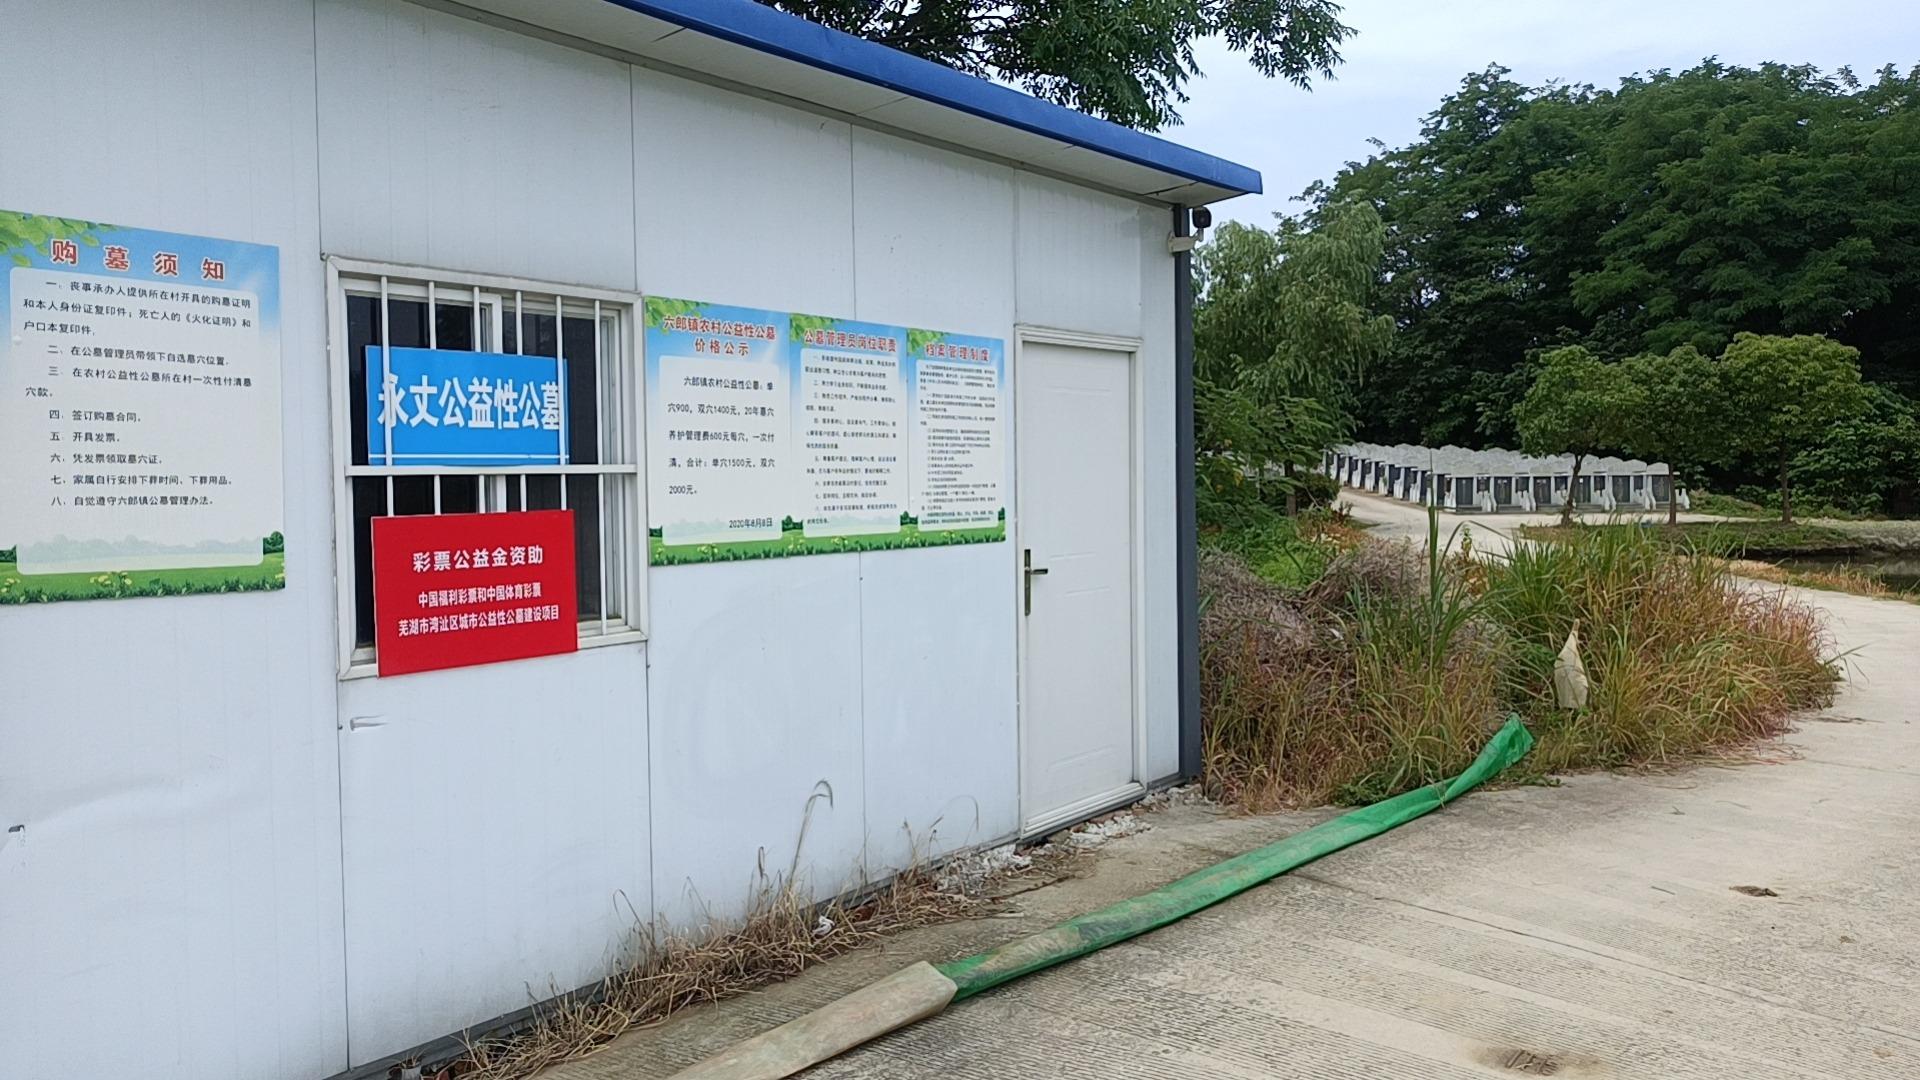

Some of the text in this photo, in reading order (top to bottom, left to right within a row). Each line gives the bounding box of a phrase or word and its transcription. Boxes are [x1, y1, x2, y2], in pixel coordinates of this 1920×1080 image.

[52, 240, 225, 280] 购墓须知
[664, 315, 776, 340] 六郎镇农村公益性公墓
[695, 338, 749, 356] 价格公示
[25, 387, 53, 398] 穴款。
[49, 410, 142, 423] 四、签订购墓合同。
[50, 431, 120, 443] 五、开具发票。
[413, 544, 543, 573] 彩票公益金资助
[418, 582, 541, 609] 中国福利彩票和中国体育彩票
[398, 605, 559, 637] 芜湖市湾沚区城市公益性公墓建设项目
